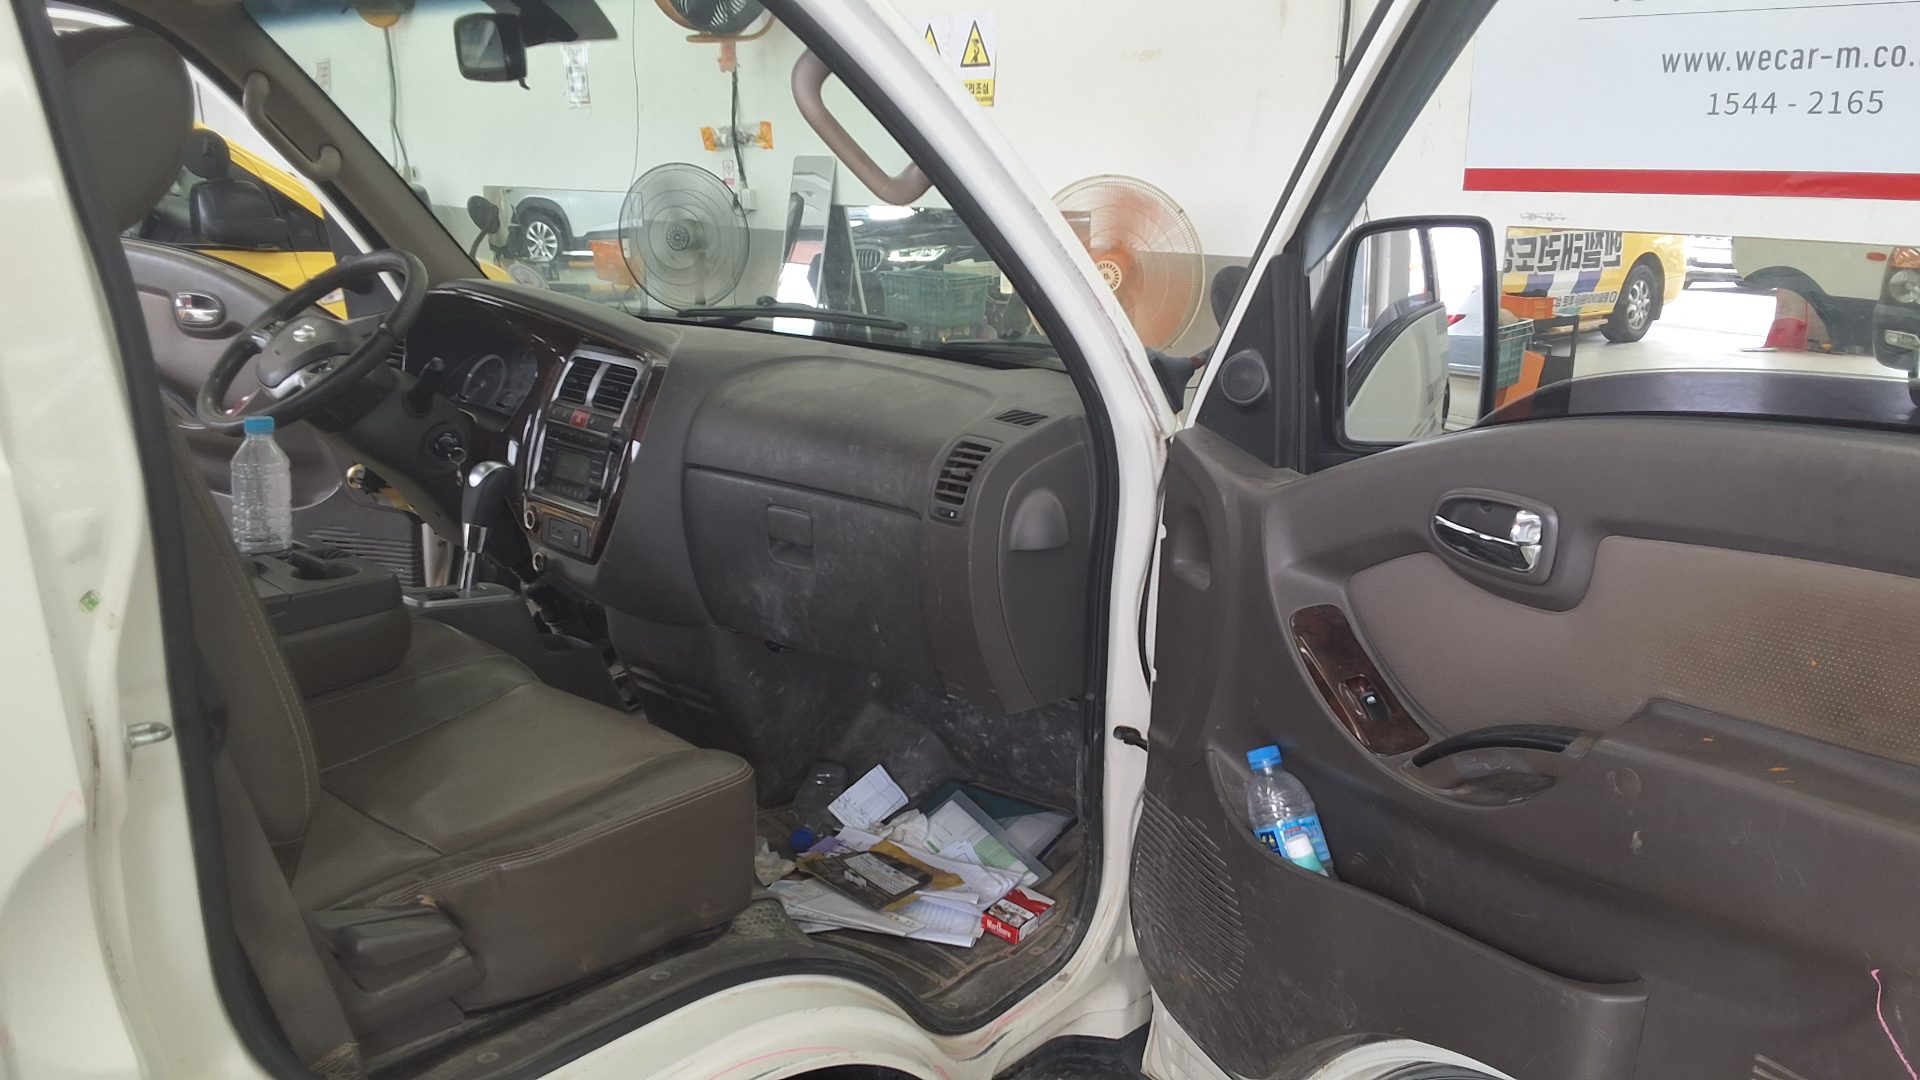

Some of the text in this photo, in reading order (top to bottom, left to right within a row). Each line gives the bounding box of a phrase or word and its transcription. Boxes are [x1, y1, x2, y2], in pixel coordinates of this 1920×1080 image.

[1661, 44, 1920, 73] www.wecar-m.co.
[964, 82, 989, 95] 리조심
[1706, 91, 1778, 116] 1544
[1807, 89, 1885, 115] 2165
